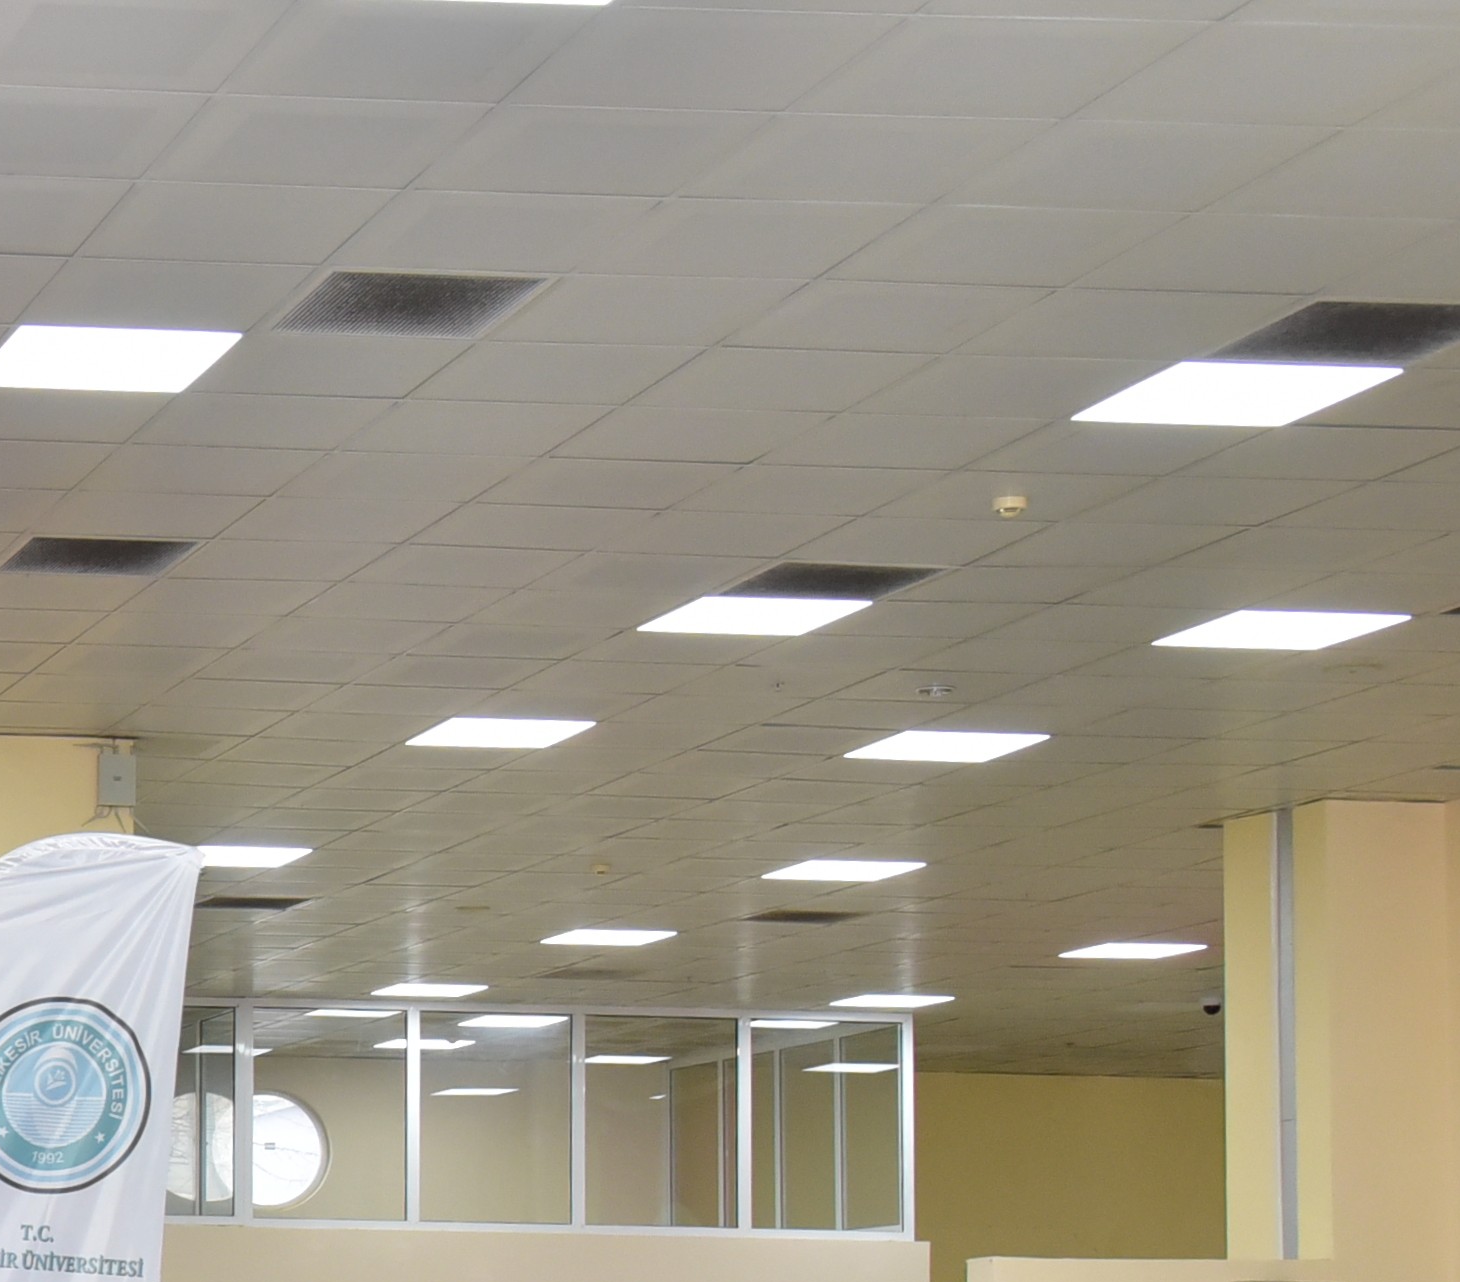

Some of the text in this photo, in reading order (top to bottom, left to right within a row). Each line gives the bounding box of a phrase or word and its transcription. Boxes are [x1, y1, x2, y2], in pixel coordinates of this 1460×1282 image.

[51, 1023, 126, 1121] ÜNİVERSİTESİ
[31, 1150, 65, 1166] 1992
[20, 1224, 55, 1244] T.C.
[22, 1249, 144, 1279] ÜNİVERSİTESİ
